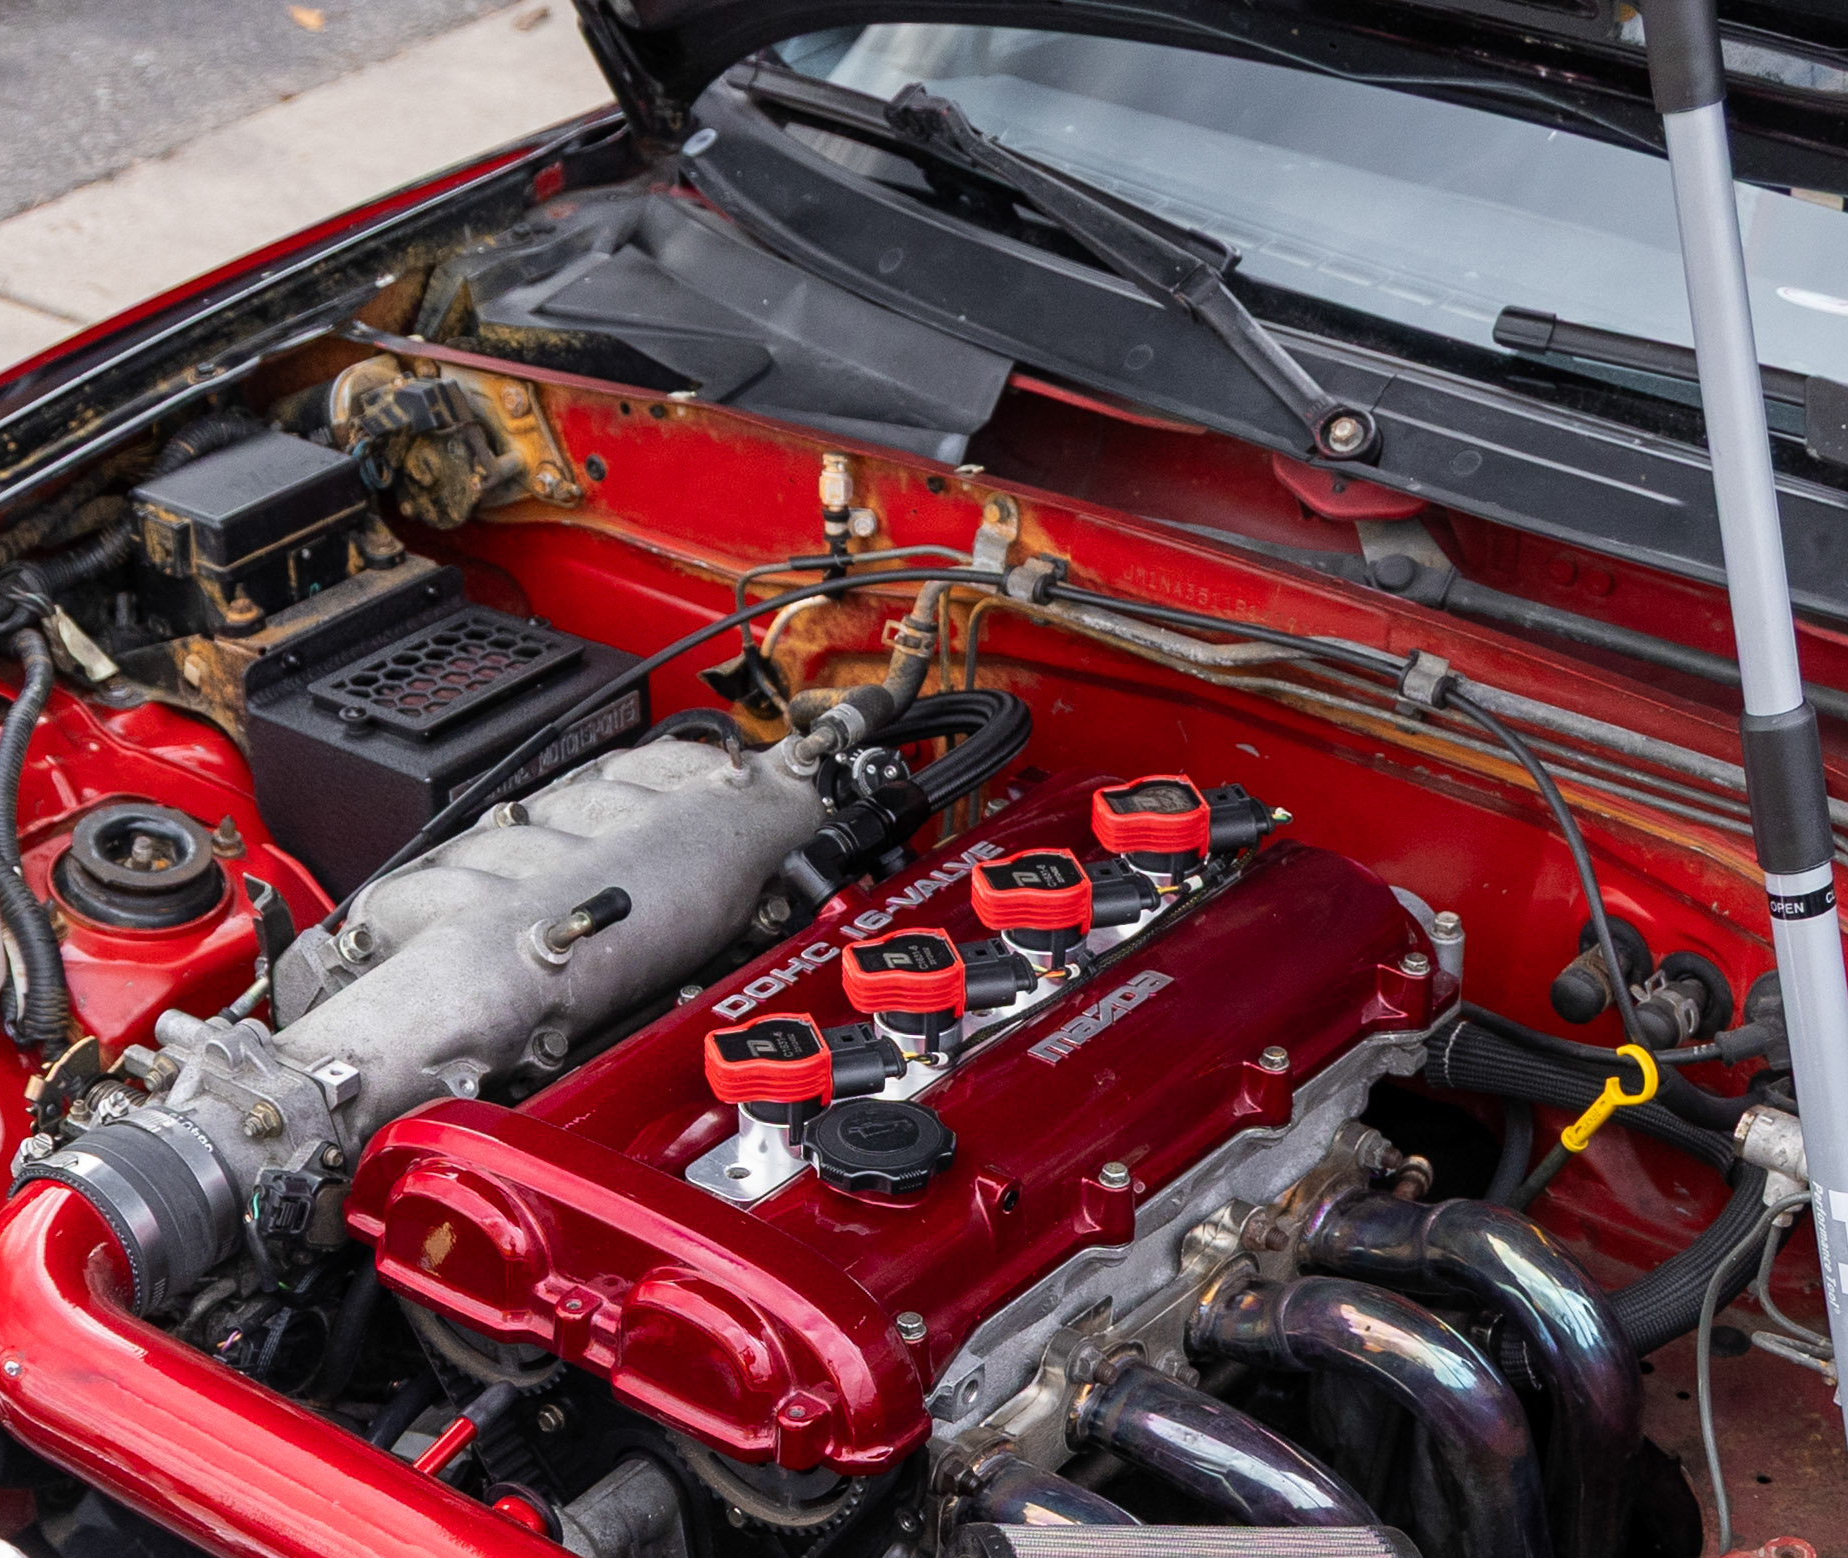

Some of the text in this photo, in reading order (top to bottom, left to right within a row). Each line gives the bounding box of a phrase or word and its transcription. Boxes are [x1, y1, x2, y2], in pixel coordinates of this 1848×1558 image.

[711, 840, 1005, 1021] DOHC 16-VALVE
[1770, 900, 1805, 915] OPEN
[1813, 1181, 1833, 1274] Performance
